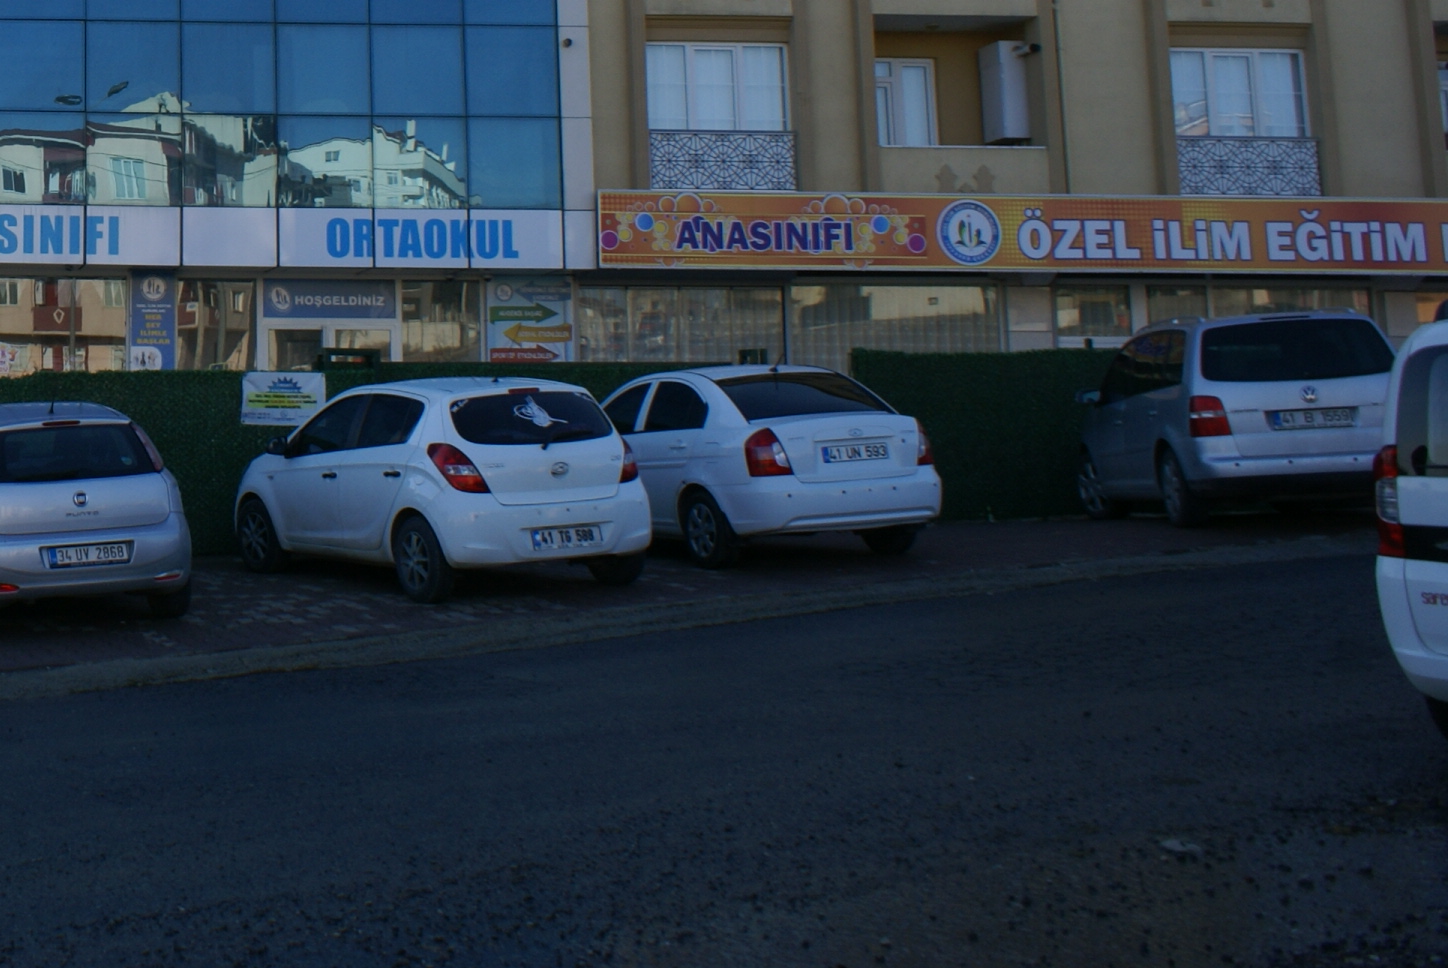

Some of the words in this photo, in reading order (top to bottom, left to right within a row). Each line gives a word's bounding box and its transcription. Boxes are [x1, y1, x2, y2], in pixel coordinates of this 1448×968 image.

[326, 217, 518, 259] ORTAOKUL
[676, 219, 854, 252] ANASINIFI
[1018, 208, 1140, 261] ÖZEL
[295, 294, 385, 307] HOŞGELDİNİZ
[829, 448, 842, 460] 41
[846, 446, 861, 459] UN
[864, 445, 887, 458] 593
[542, 531, 553, 545] 41
[57, 549, 71, 562] 34
[95, 545, 124, 560] 2868
